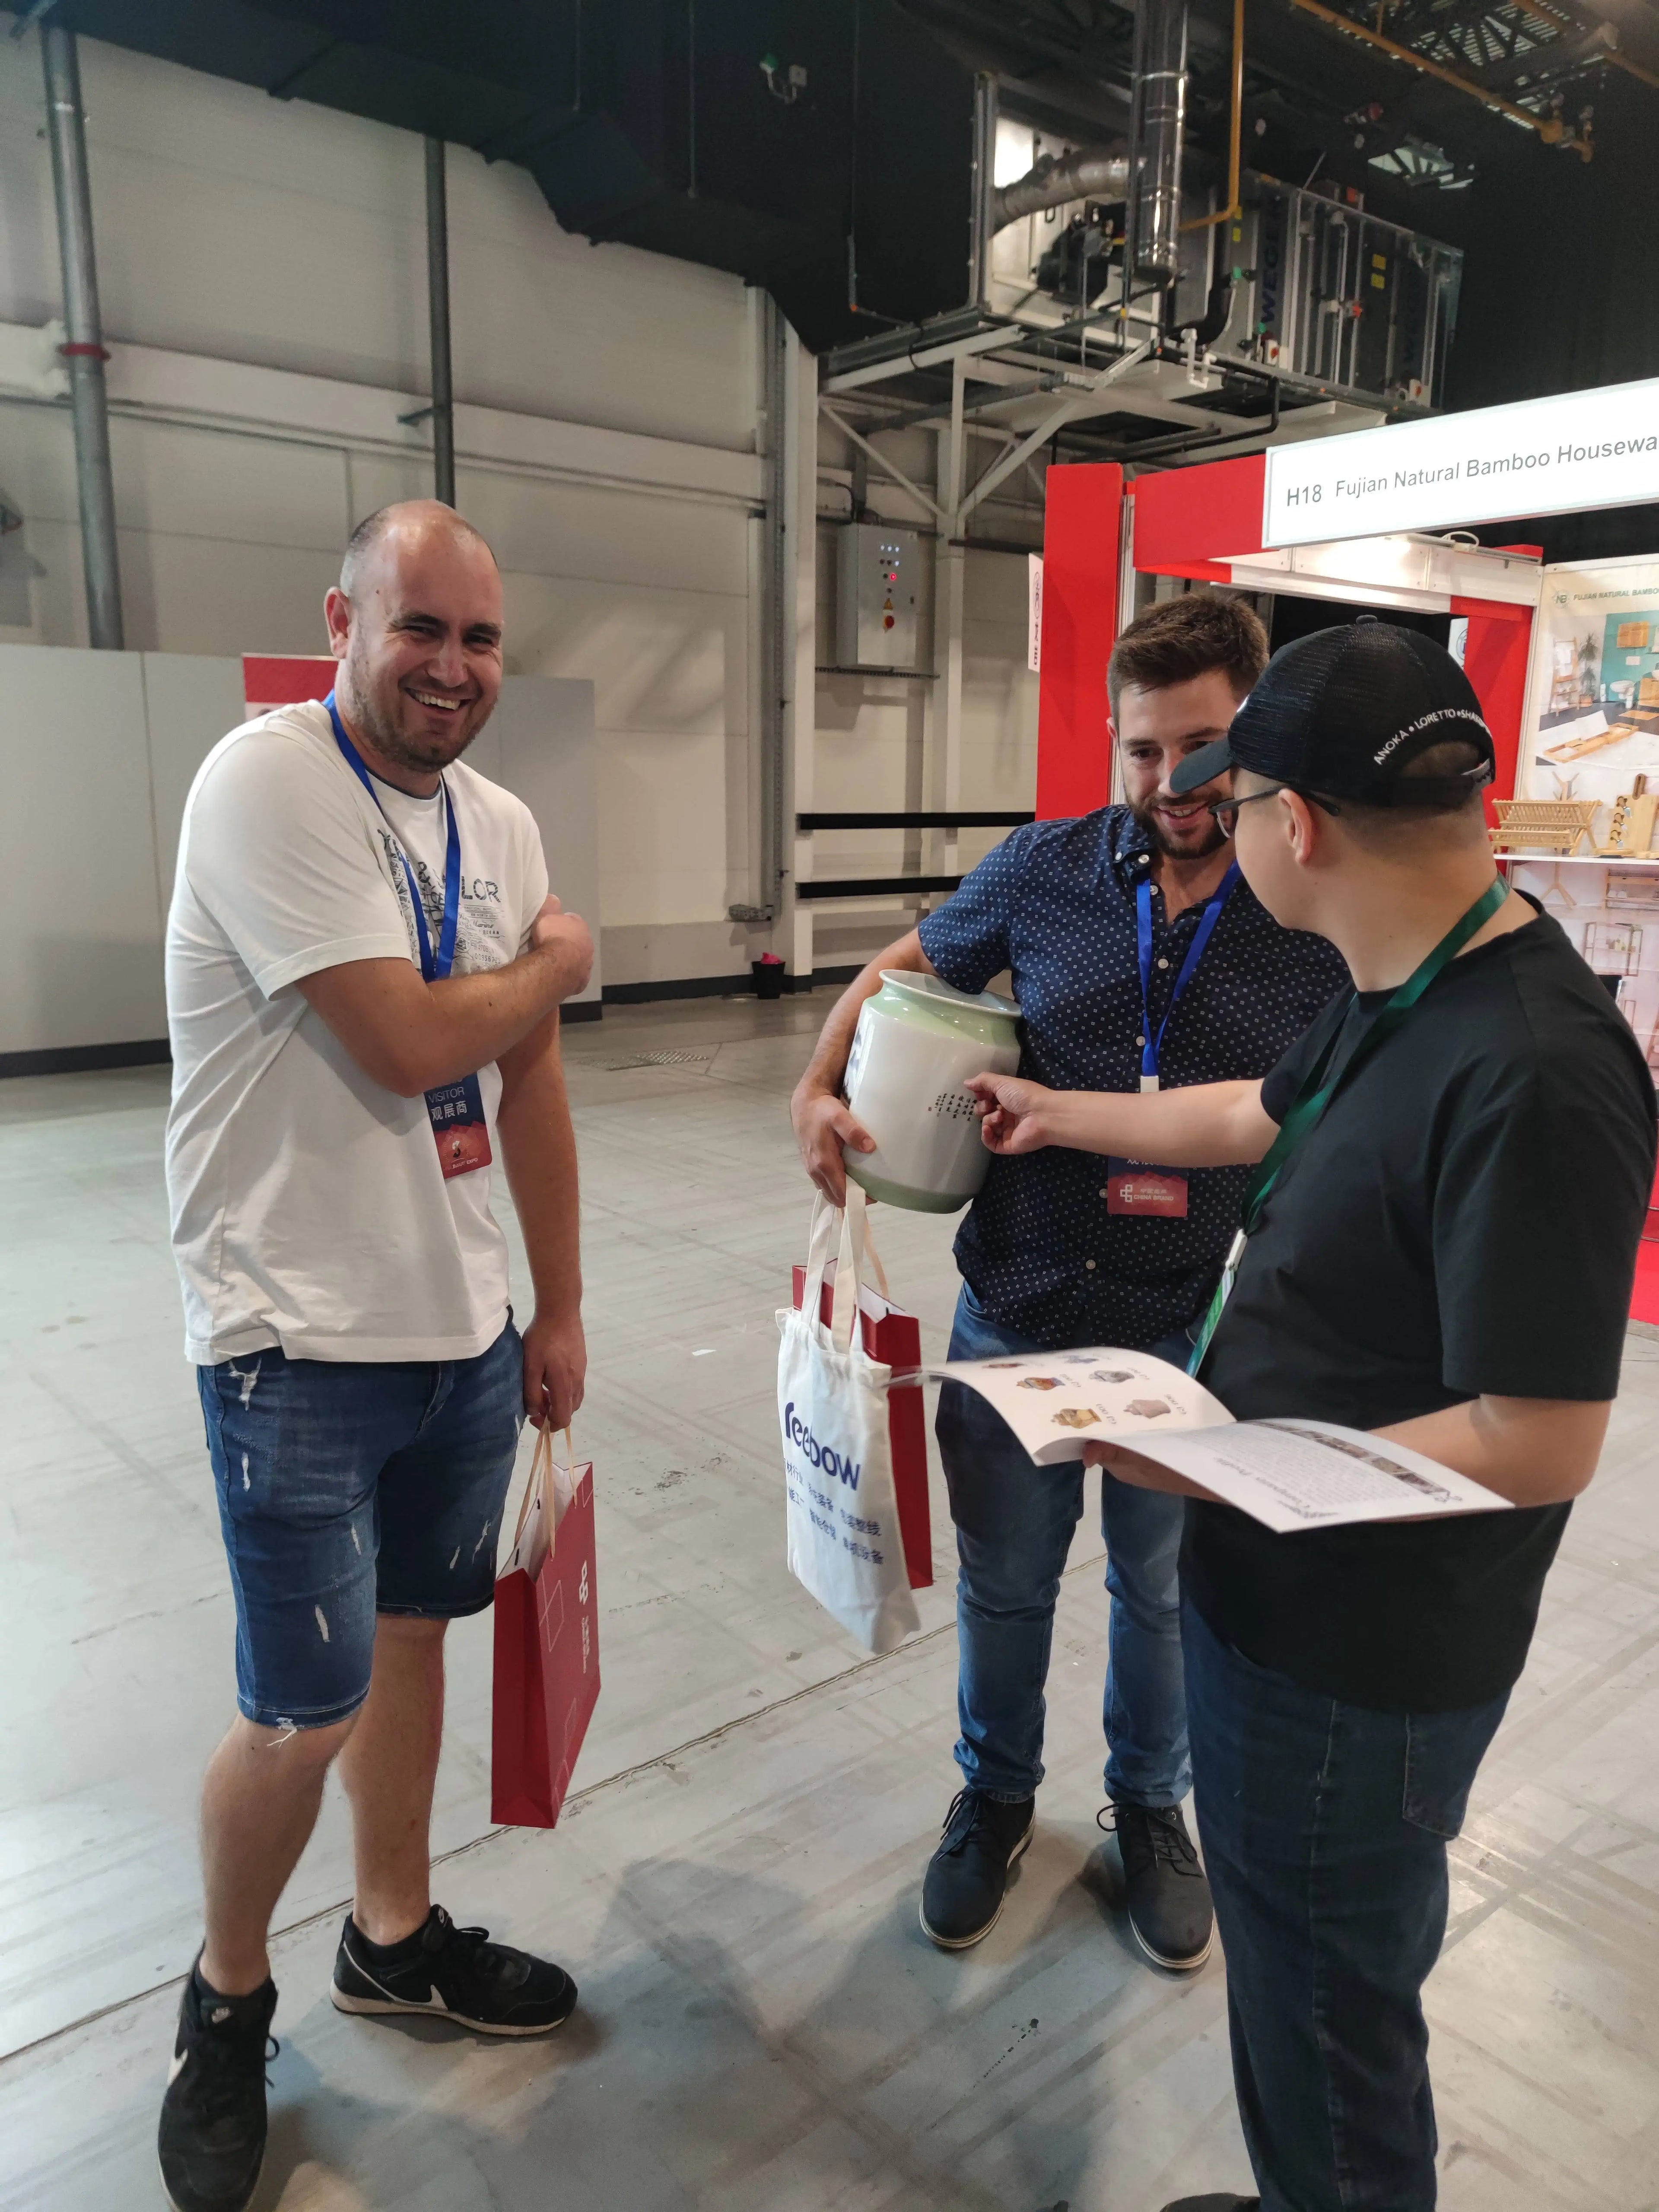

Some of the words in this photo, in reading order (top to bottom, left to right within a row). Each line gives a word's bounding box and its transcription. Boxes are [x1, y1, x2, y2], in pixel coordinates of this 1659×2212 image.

[1287, 484, 1322, 507] H18
[1336, 477, 1388, 499] Fujian
[1394, 462, 1459, 488] Natural
[1467, 453, 1550, 477] Bamboo
[1557, 436, 1658, 464] Housewa
[1632, 587, 1659, 596] BAMBO
[1374, 730, 1409, 765] ANOKA
[1414, 708, 1456, 729] LORETTO
[428, 1086, 465, 1103] VISITOR
[431, 1100, 467, 1122] 观展商
